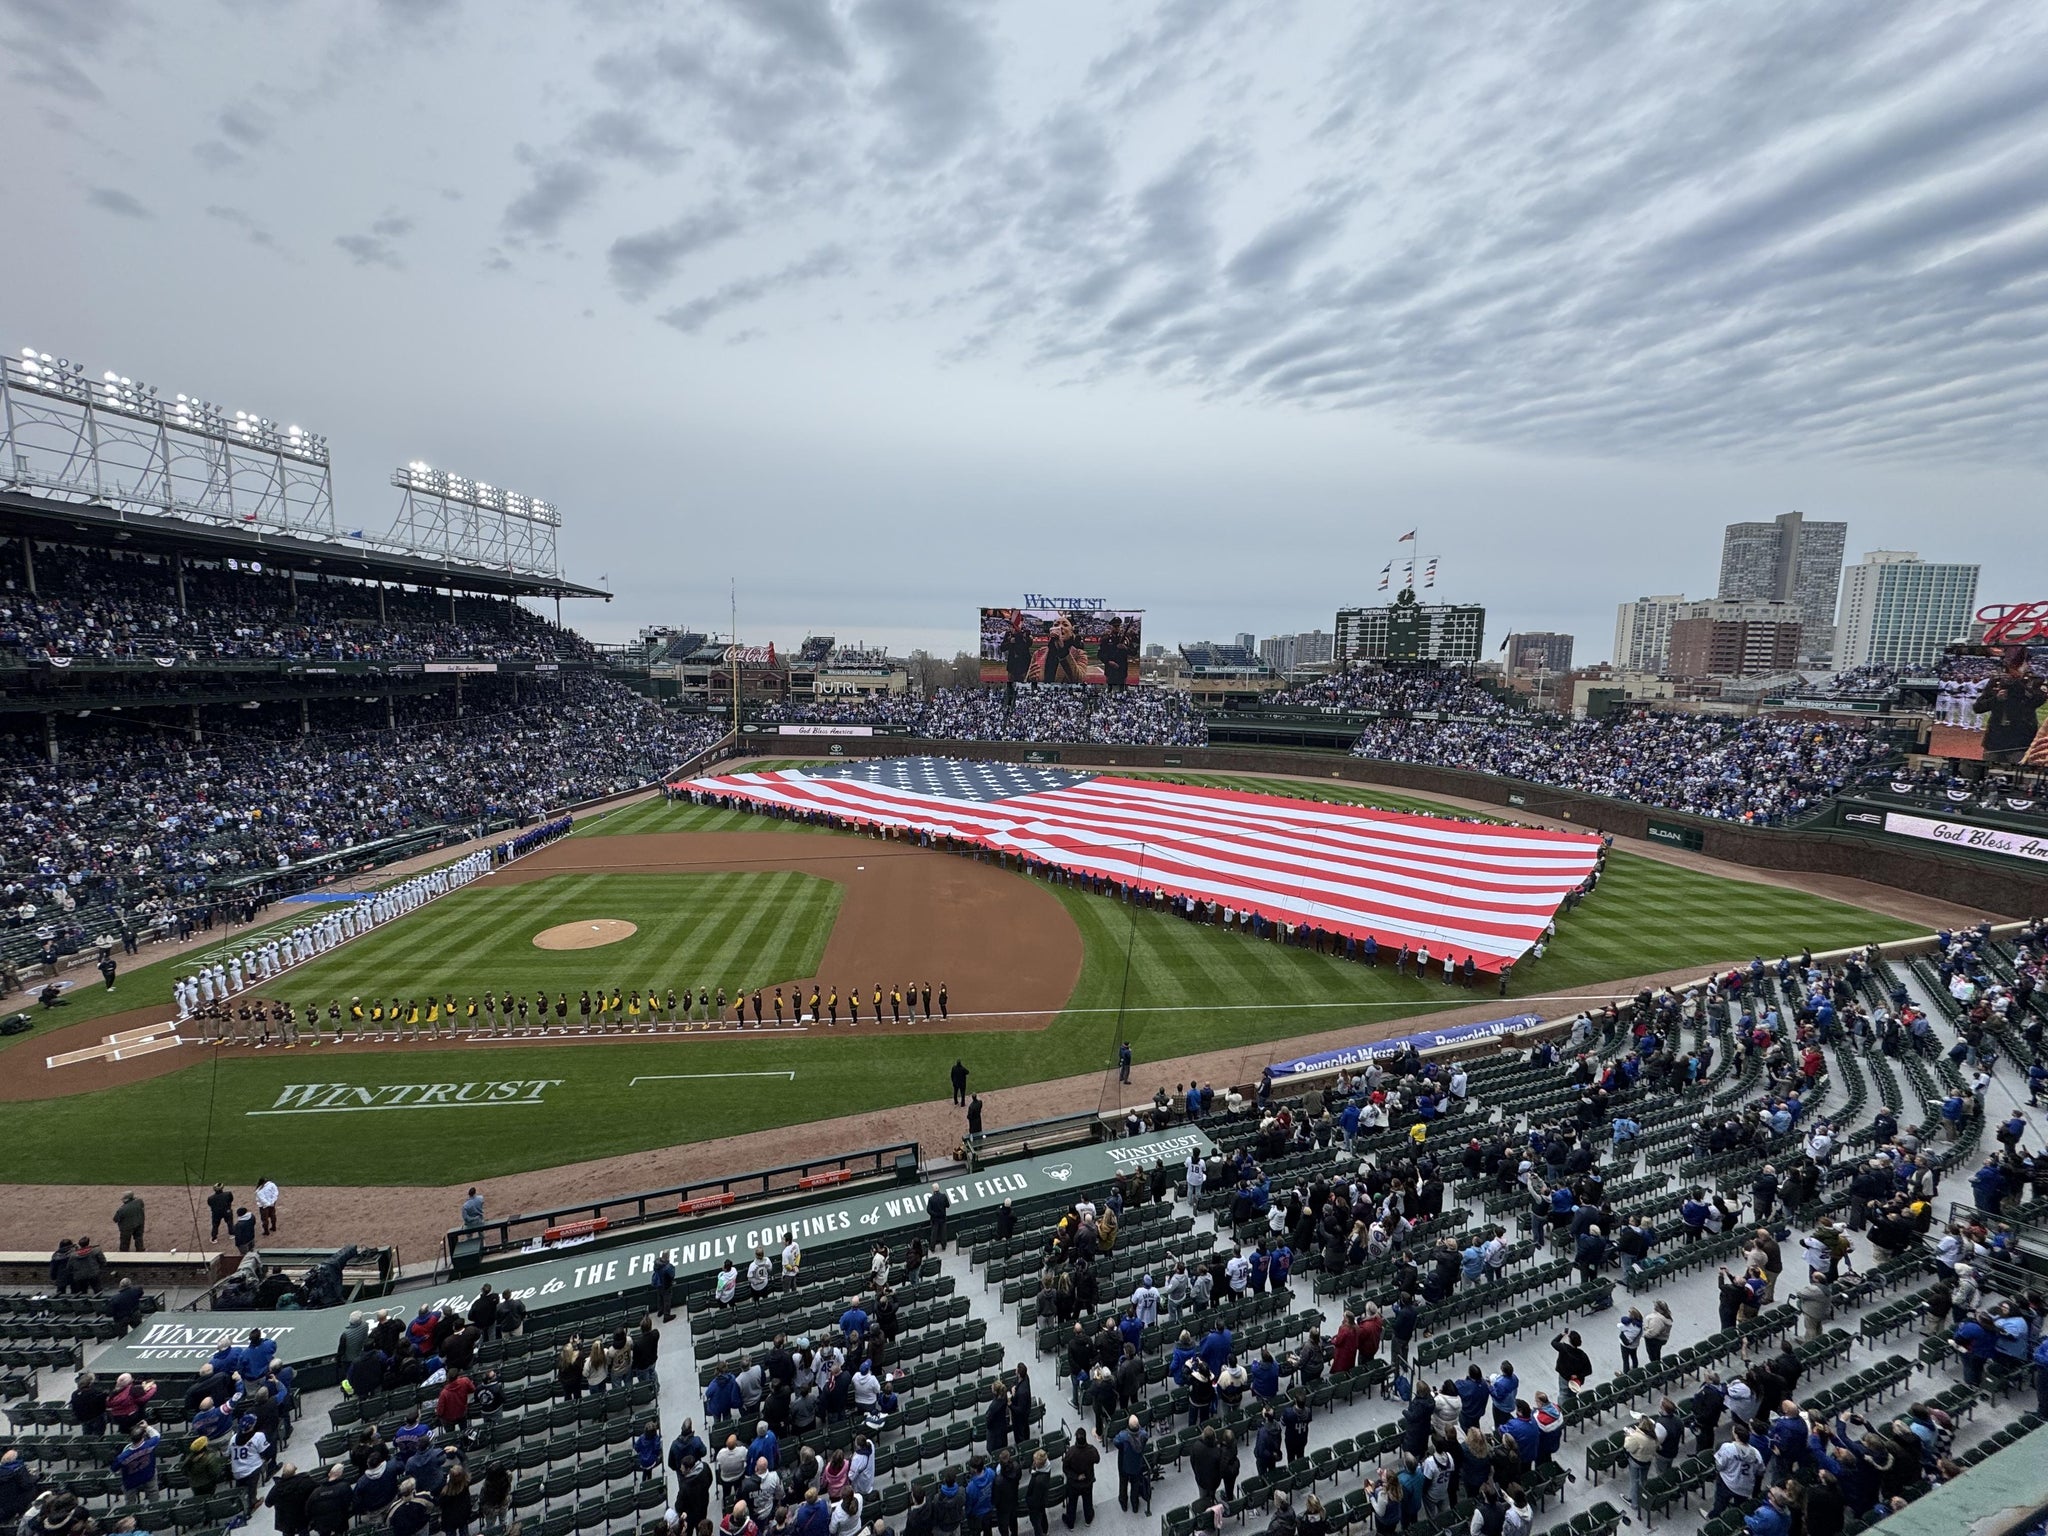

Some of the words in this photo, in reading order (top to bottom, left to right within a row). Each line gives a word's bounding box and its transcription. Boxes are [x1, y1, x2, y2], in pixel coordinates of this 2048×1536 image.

[1023, 593, 1106, 610] WINTRUST
[1420, 606, 1453, 614] AMERICAN
[1447, 713, 1489, 724] Budweiser
[1504, 718, 1533, 726] Advocate
[1648, 827, 1682, 841] SLOAN
[1932, 824, 1966, 841] God
[1967, 828, 2013, 851] Bless
[272, 1079, 565, 1108] WINTRUST
[1105, 1134, 1198, 1161] WINTRUST
[691, 1199, 722, 1210] GATORADE
[559, 1225, 594, 1236] GATORADE
[432, 1286, 537, 1314] Welme
[540, 1277, 567, 1293] to
[573, 1260, 619, 1288] THE
[746, 1211, 851, 1250] CONFINES
[859, 1206, 880, 1226] of
[885, 1184, 969, 1218] WRIEY
[974, 1173, 1028, 1198] FIELD
[139, 1324, 296, 1345] WINTRUST
[233, 1447, 248, 1461] 18
